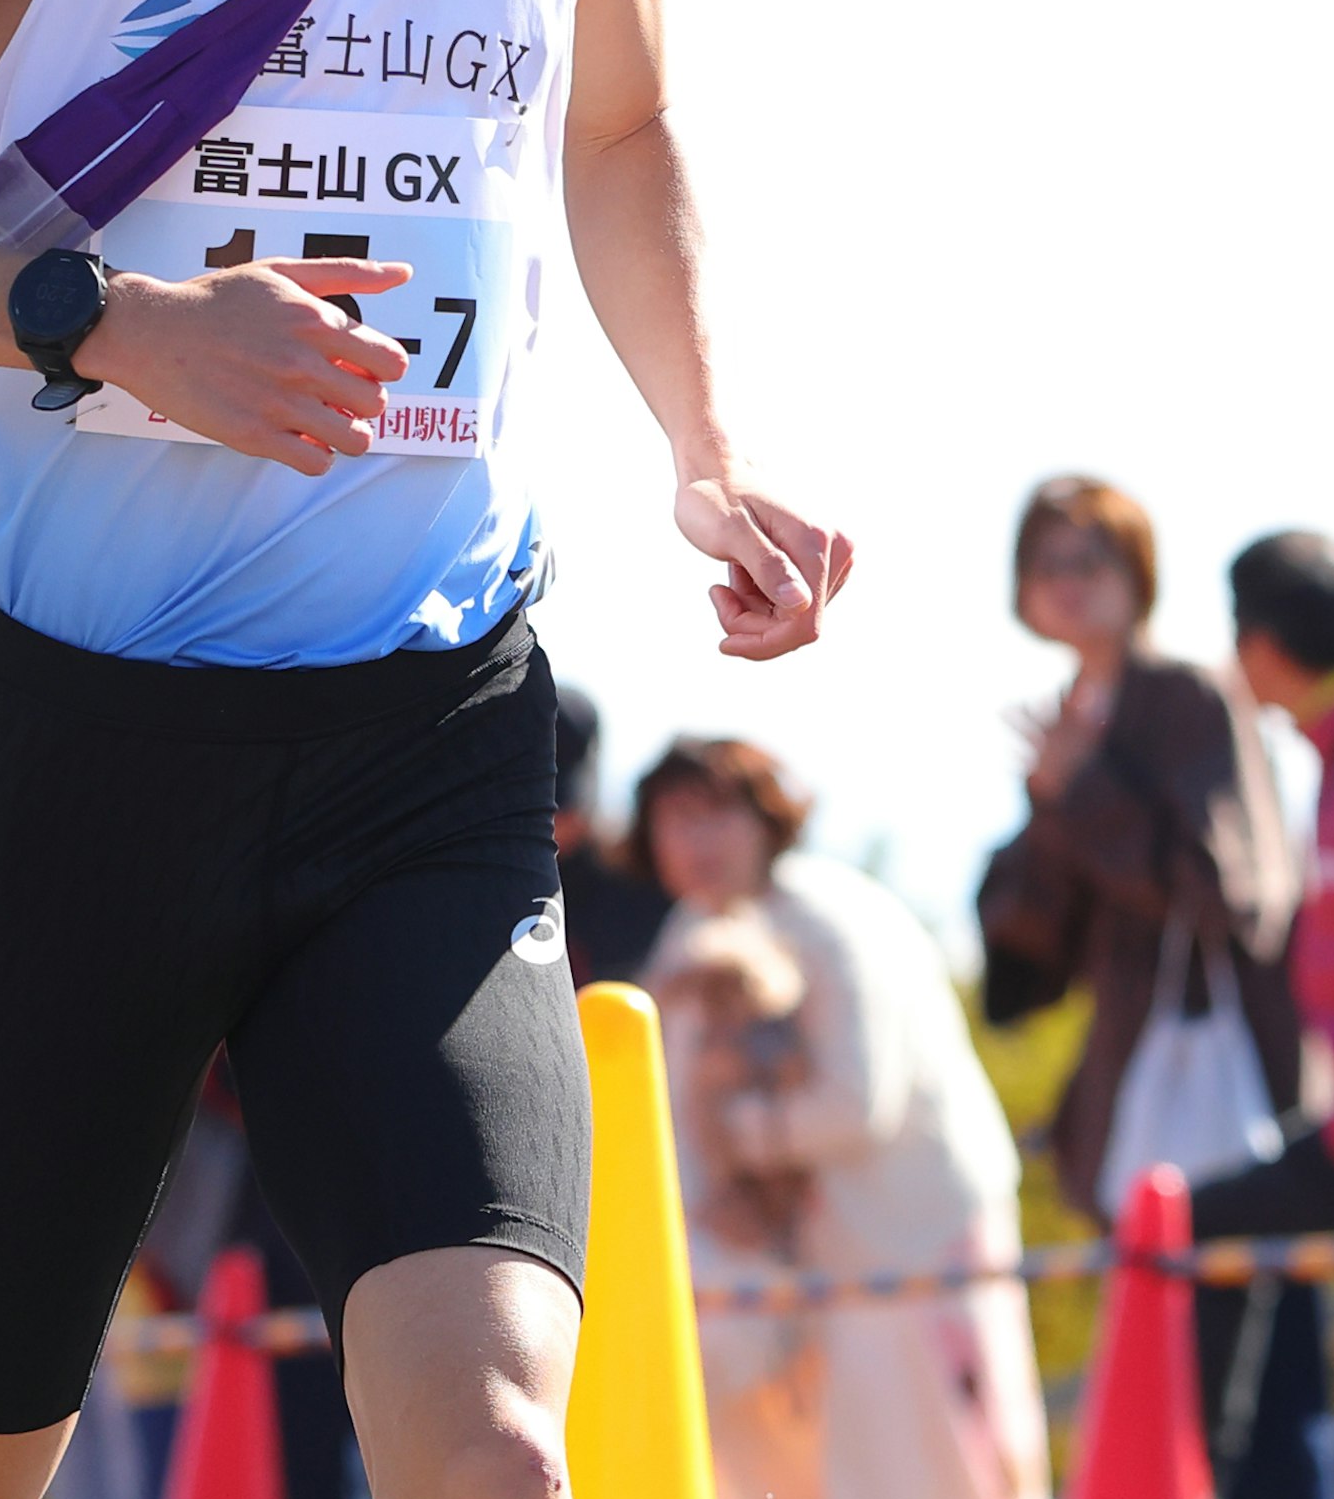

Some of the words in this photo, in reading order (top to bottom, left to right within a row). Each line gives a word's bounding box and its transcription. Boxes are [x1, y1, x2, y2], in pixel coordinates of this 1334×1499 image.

[193, 137, 367, 202] 富士山
[385, 152, 461, 204] GX
